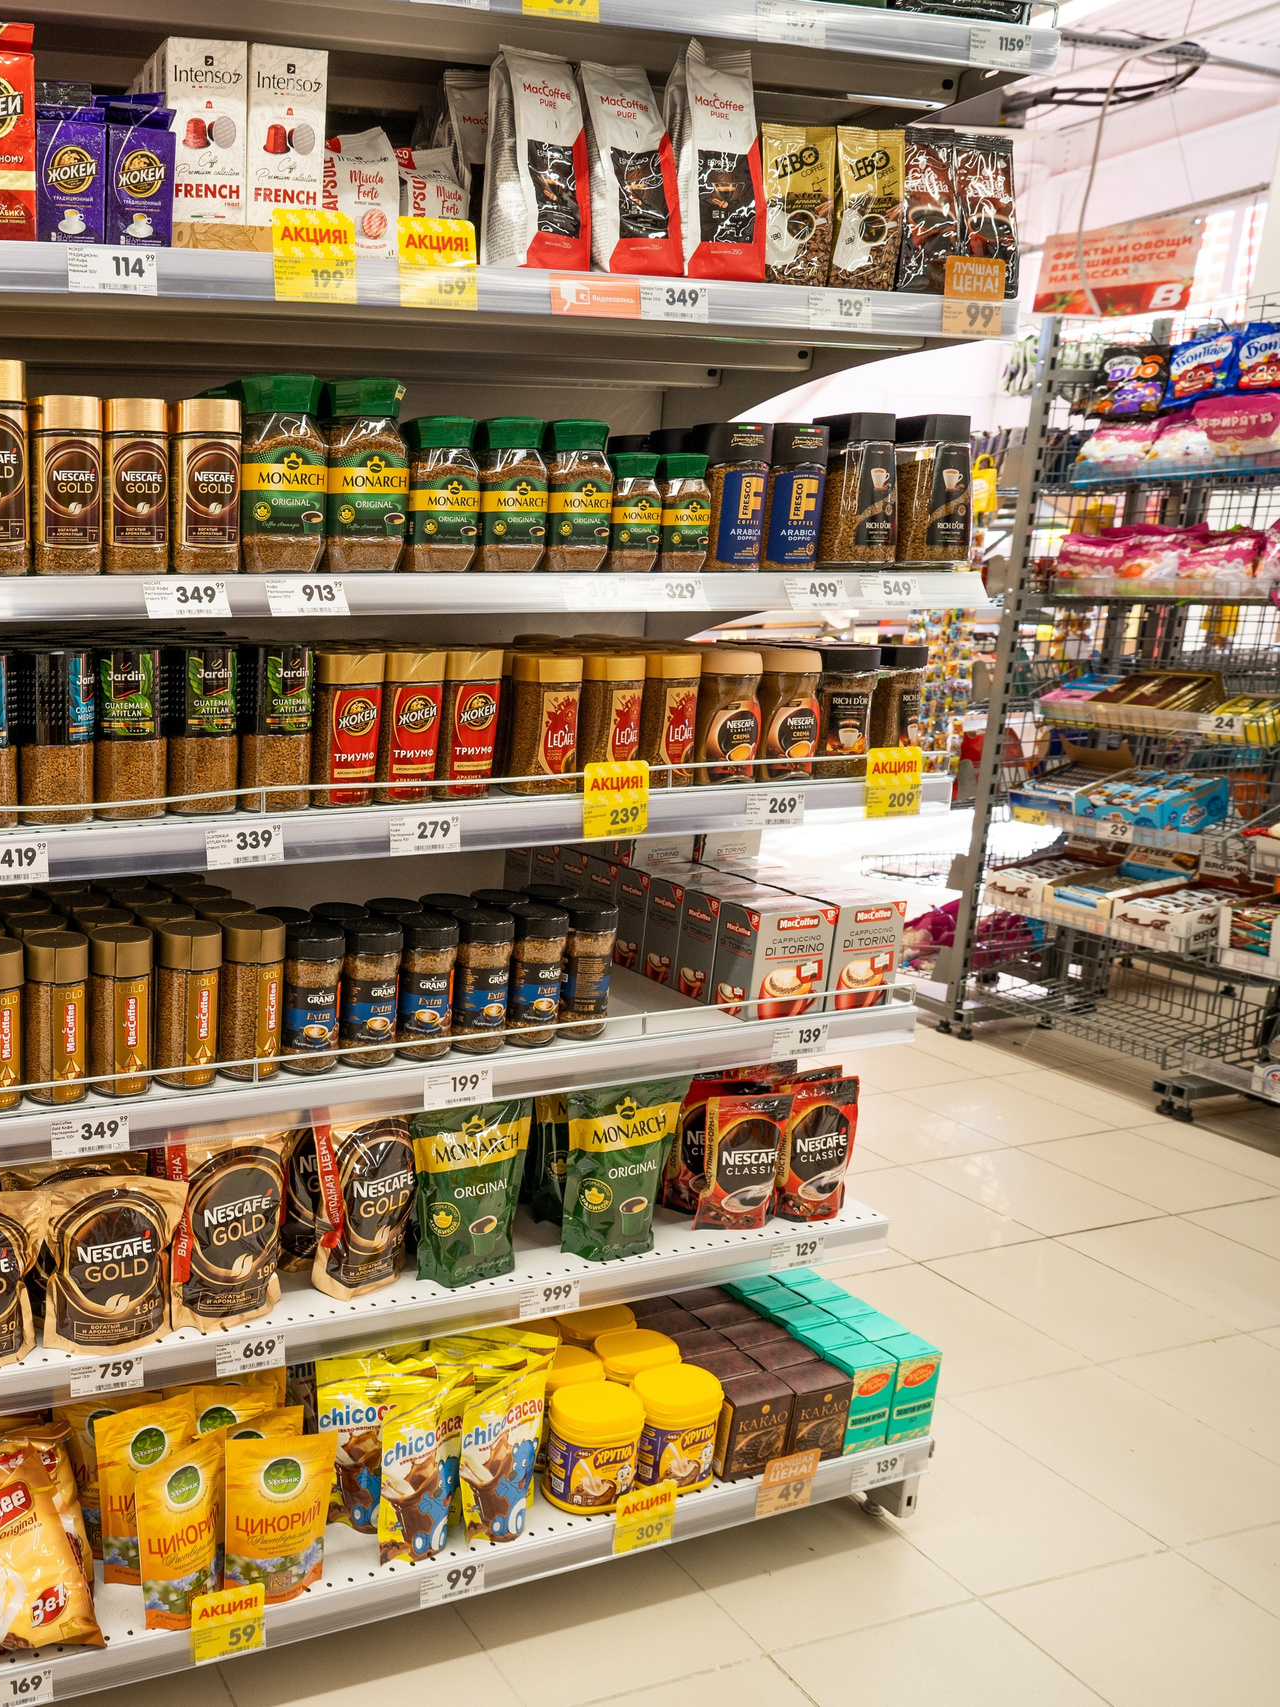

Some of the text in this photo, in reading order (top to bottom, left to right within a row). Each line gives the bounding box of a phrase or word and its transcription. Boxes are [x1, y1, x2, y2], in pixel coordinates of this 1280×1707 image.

[999, 36, 1023, 52] 1159
[600, 93, 649, 113] MacCoffee
[617, 110, 637, 120] PURE
[175, 183, 240, 201] FRENCH
[405, 232, 469, 252] АКЦИЯ!
[1132, 236, 1193, 250] ОВОЩИ
[112, 256, 145, 278] 114
[952, 261, 1000, 275] ЛУЧШАЯ
[1051, 250, 1177, 272] ВЗВШИВАЮТСЯ
[952, 274, 999, 294] ЦЕНА!
[1048, 275, 1067, 283] НА
[665, 287, 698, 308] 349
[966, 302, 992, 328] 99
[258, 471, 325, 487] MONARCH
[271, 497, 311, 508] ORIGINAL
[730, 528, 761, 537] ARABICA
[737, 534, 758, 542] DOPPIO
[175, 585, 215, 604] 349
[301, 584, 335, 602] 913
[1214, 717, 1235, 730] 24
[334, 752, 375, 763] ТРИУМФ
[590, 775, 643, 792] АКЦИЯ!
[610, 806, 640, 826] 239
[1110, 824, 1128, 836] 29
[236, 829, 273, 851] 339
[0, 848, 36, 868] 419
[765, 941, 825, 956] DI TORINO
[771, 935, 822, 945] CAPPUCCINO
[798, 1028, 821, 1043] 139
[81, 1121, 120, 1141] 349
[797, 1127, 848, 1153] NESCAFÉ
[801, 1149, 844, 1162] CLASSIC
[204, 1189, 274, 1228] NESCAFÉ
[543, 1284, 573, 1303] 999
[242, 1339, 276, 1358] 669
[463, 1400, 543, 1449] chicocacao
[739, 1411, 788, 1433] КАКАО
[596, 1445, 632, 1465] ХРУТКА
[876, 1458, 897, 1474] 139
[622, 1492, 671, 1517] АКЦИЯ!
[0, 1512, 37, 1543] Original
[235, 1502, 321, 1535] ЦИКОРИЙ
[636, 1522, 664, 1540] 309
[447, 1566, 478, 1590] 99
[227, 1625, 255, 1647] 59
[10, 1674, 42, 1695] 169
